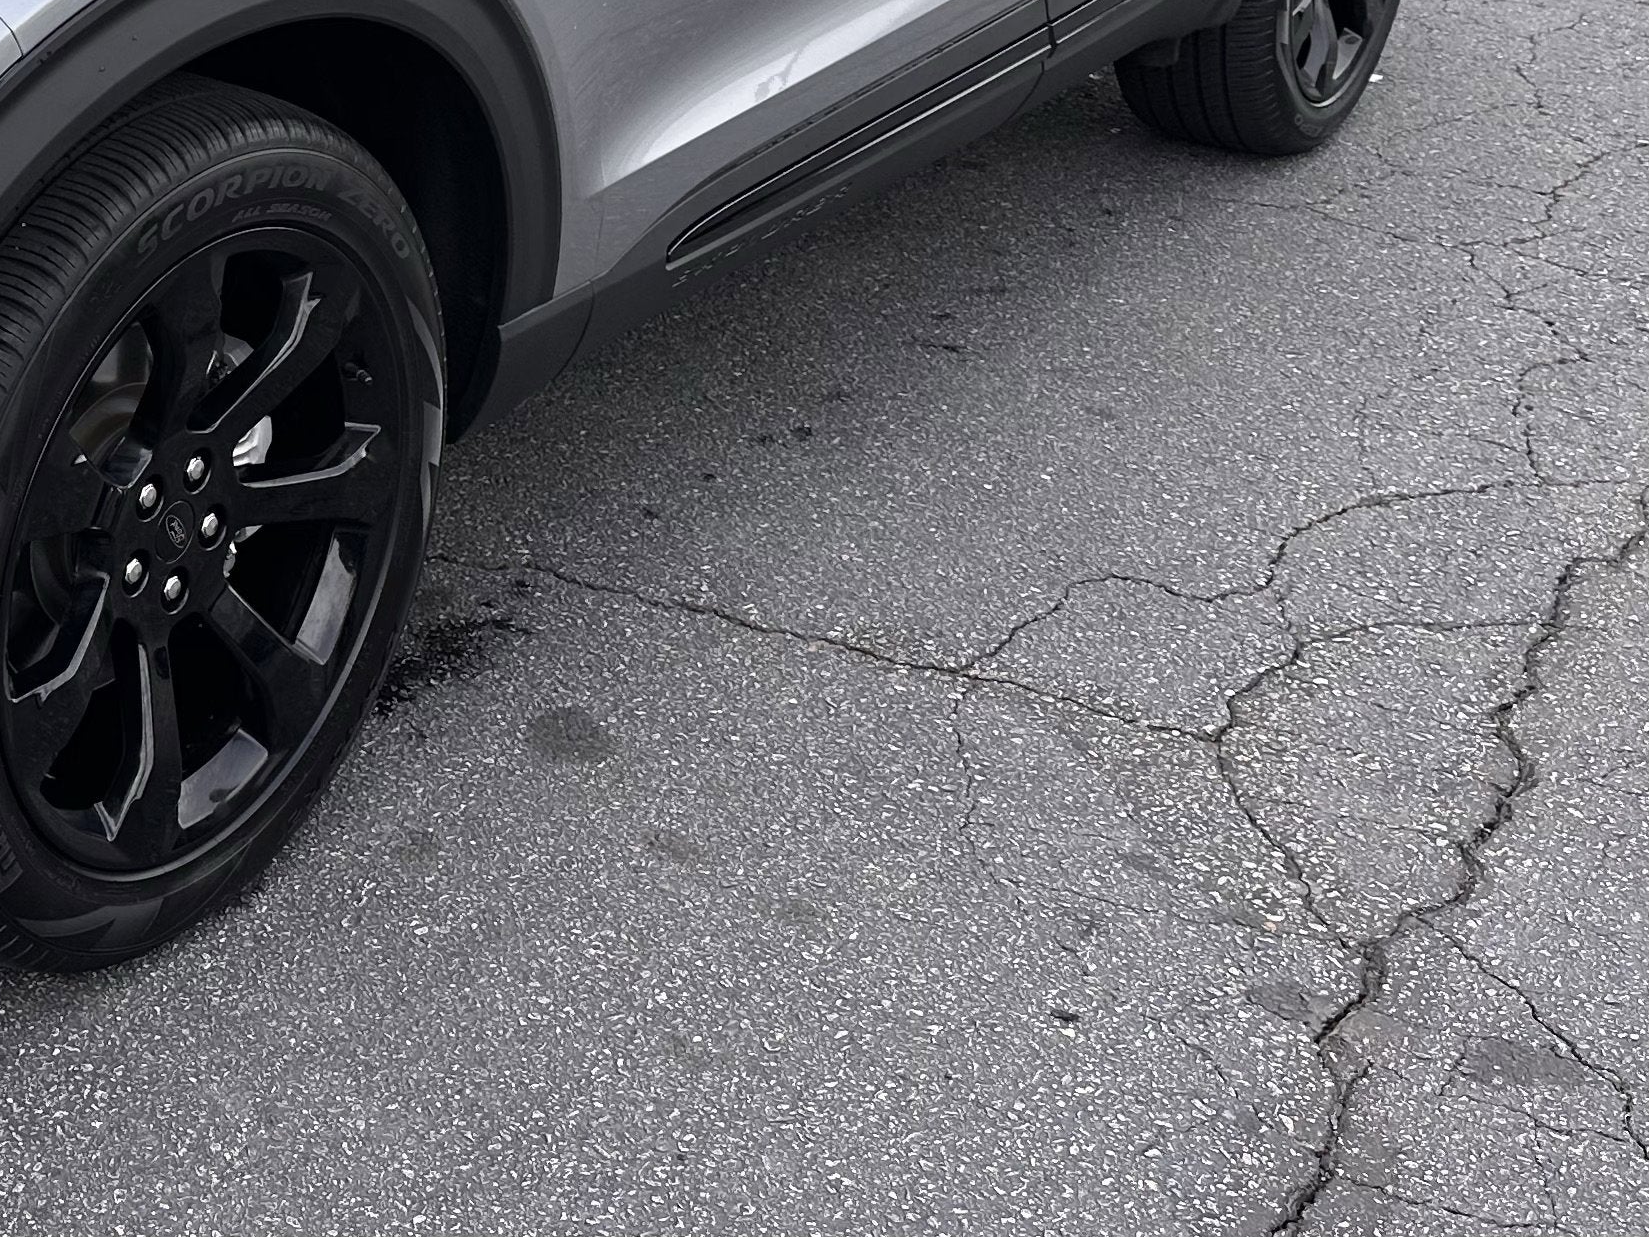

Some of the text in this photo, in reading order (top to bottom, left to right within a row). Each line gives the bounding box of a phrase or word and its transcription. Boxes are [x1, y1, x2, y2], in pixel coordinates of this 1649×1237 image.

[137, 165, 411, 259] SCORPION ZERO
[266, 202, 333, 223] SEASON
